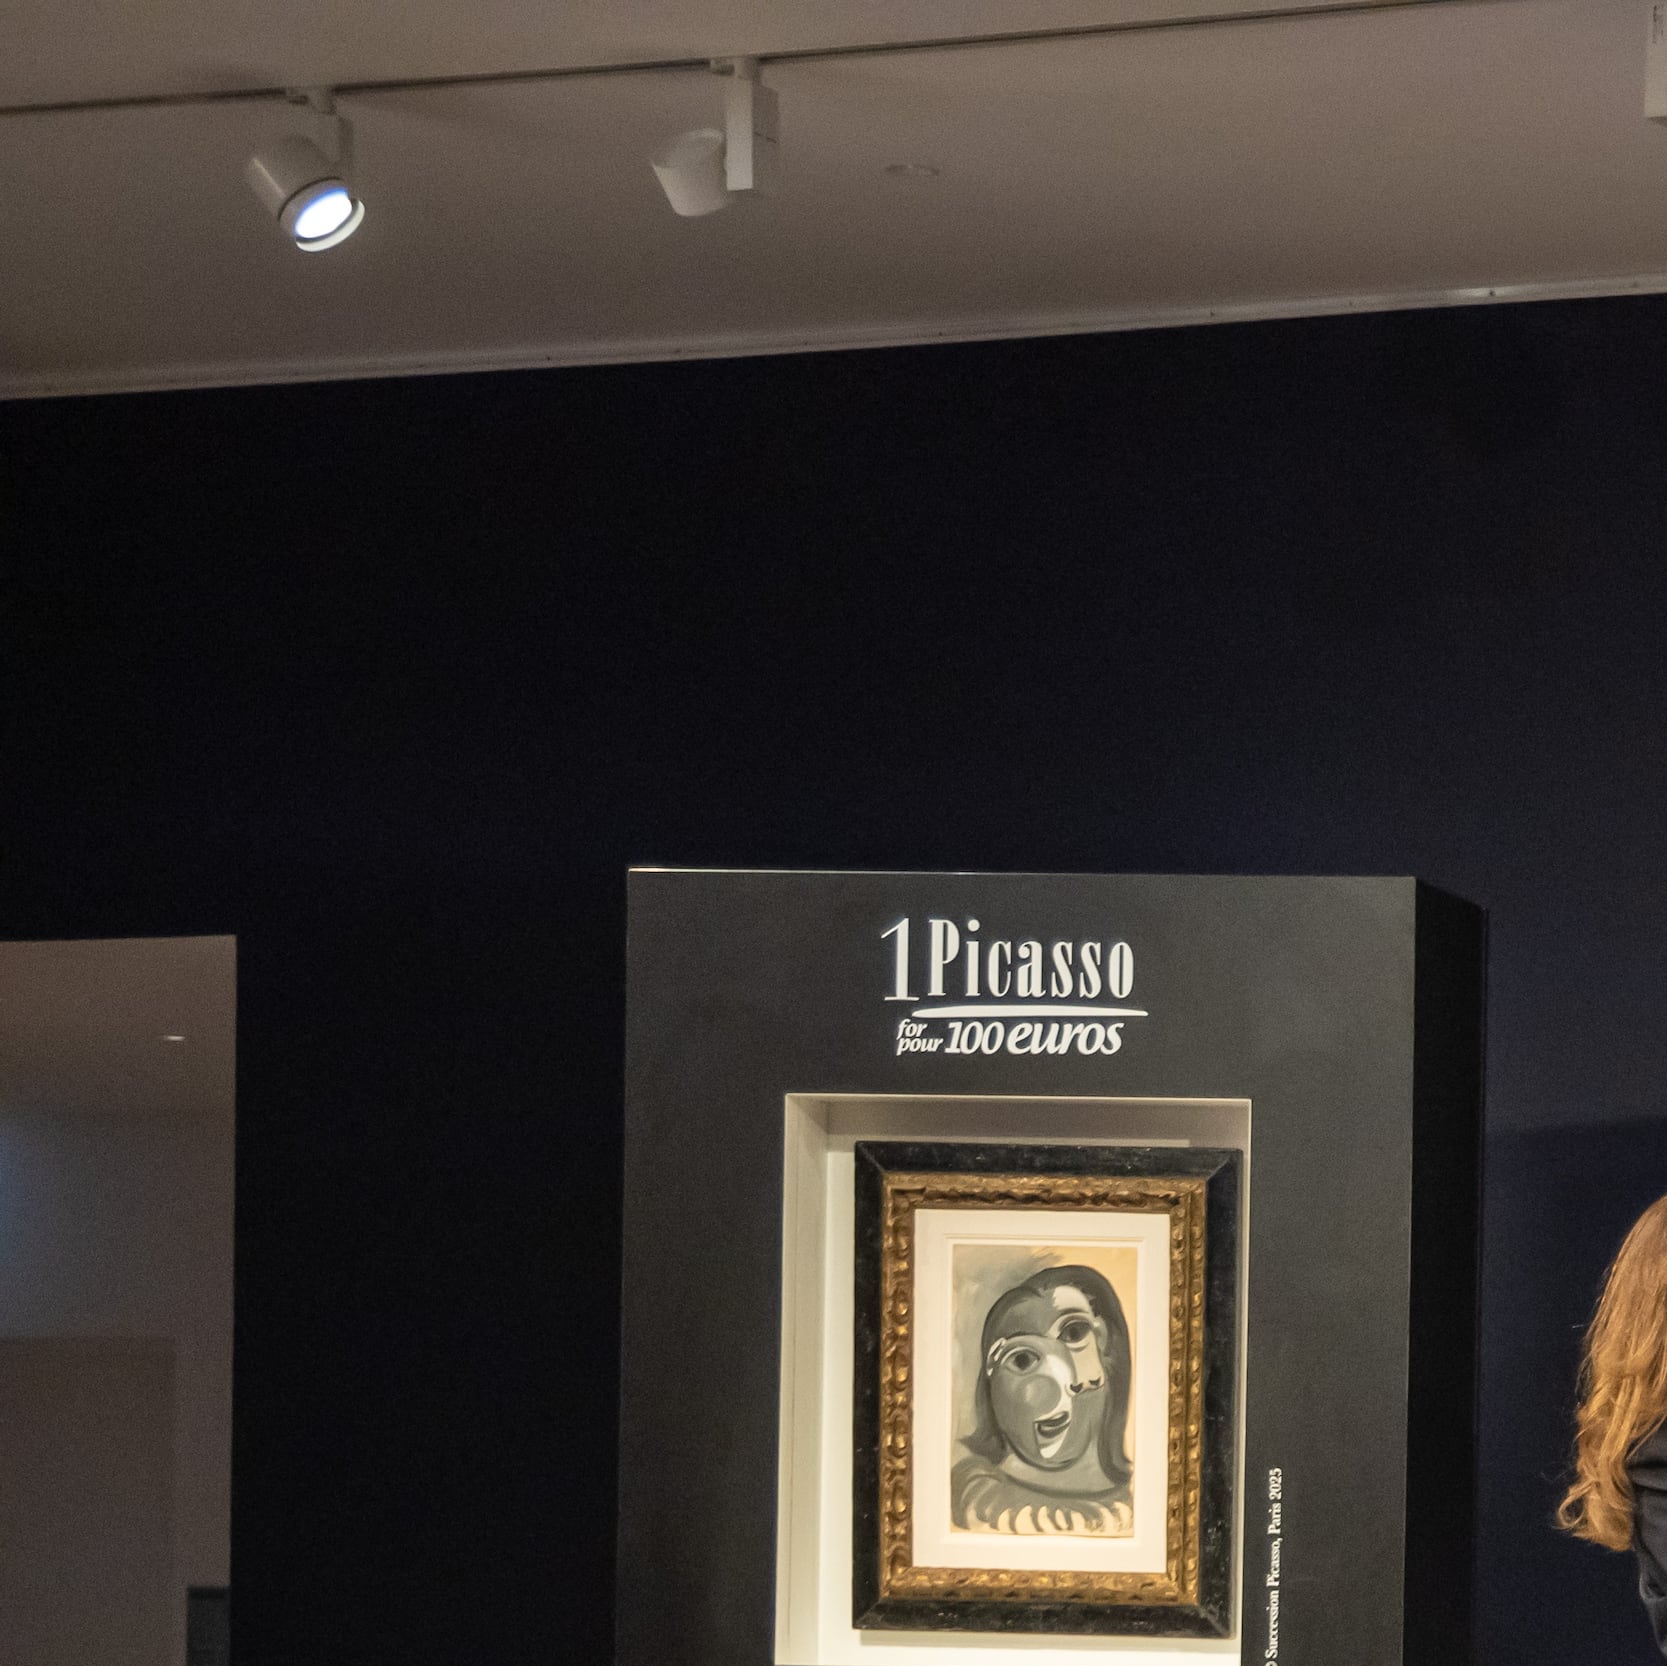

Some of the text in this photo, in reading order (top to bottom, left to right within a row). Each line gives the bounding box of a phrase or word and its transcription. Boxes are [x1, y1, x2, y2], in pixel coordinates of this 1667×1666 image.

[896, 1018, 928, 1040] for
[896, 1036, 943, 1056] pour
[1269, 1467, 1283, 1500] 2025
[1267, 1502, 1282, 1535] Paris
[1266, 1537, 1283, 1587] Picasso,
[1264, 1590, 1280, 1659] Succession
